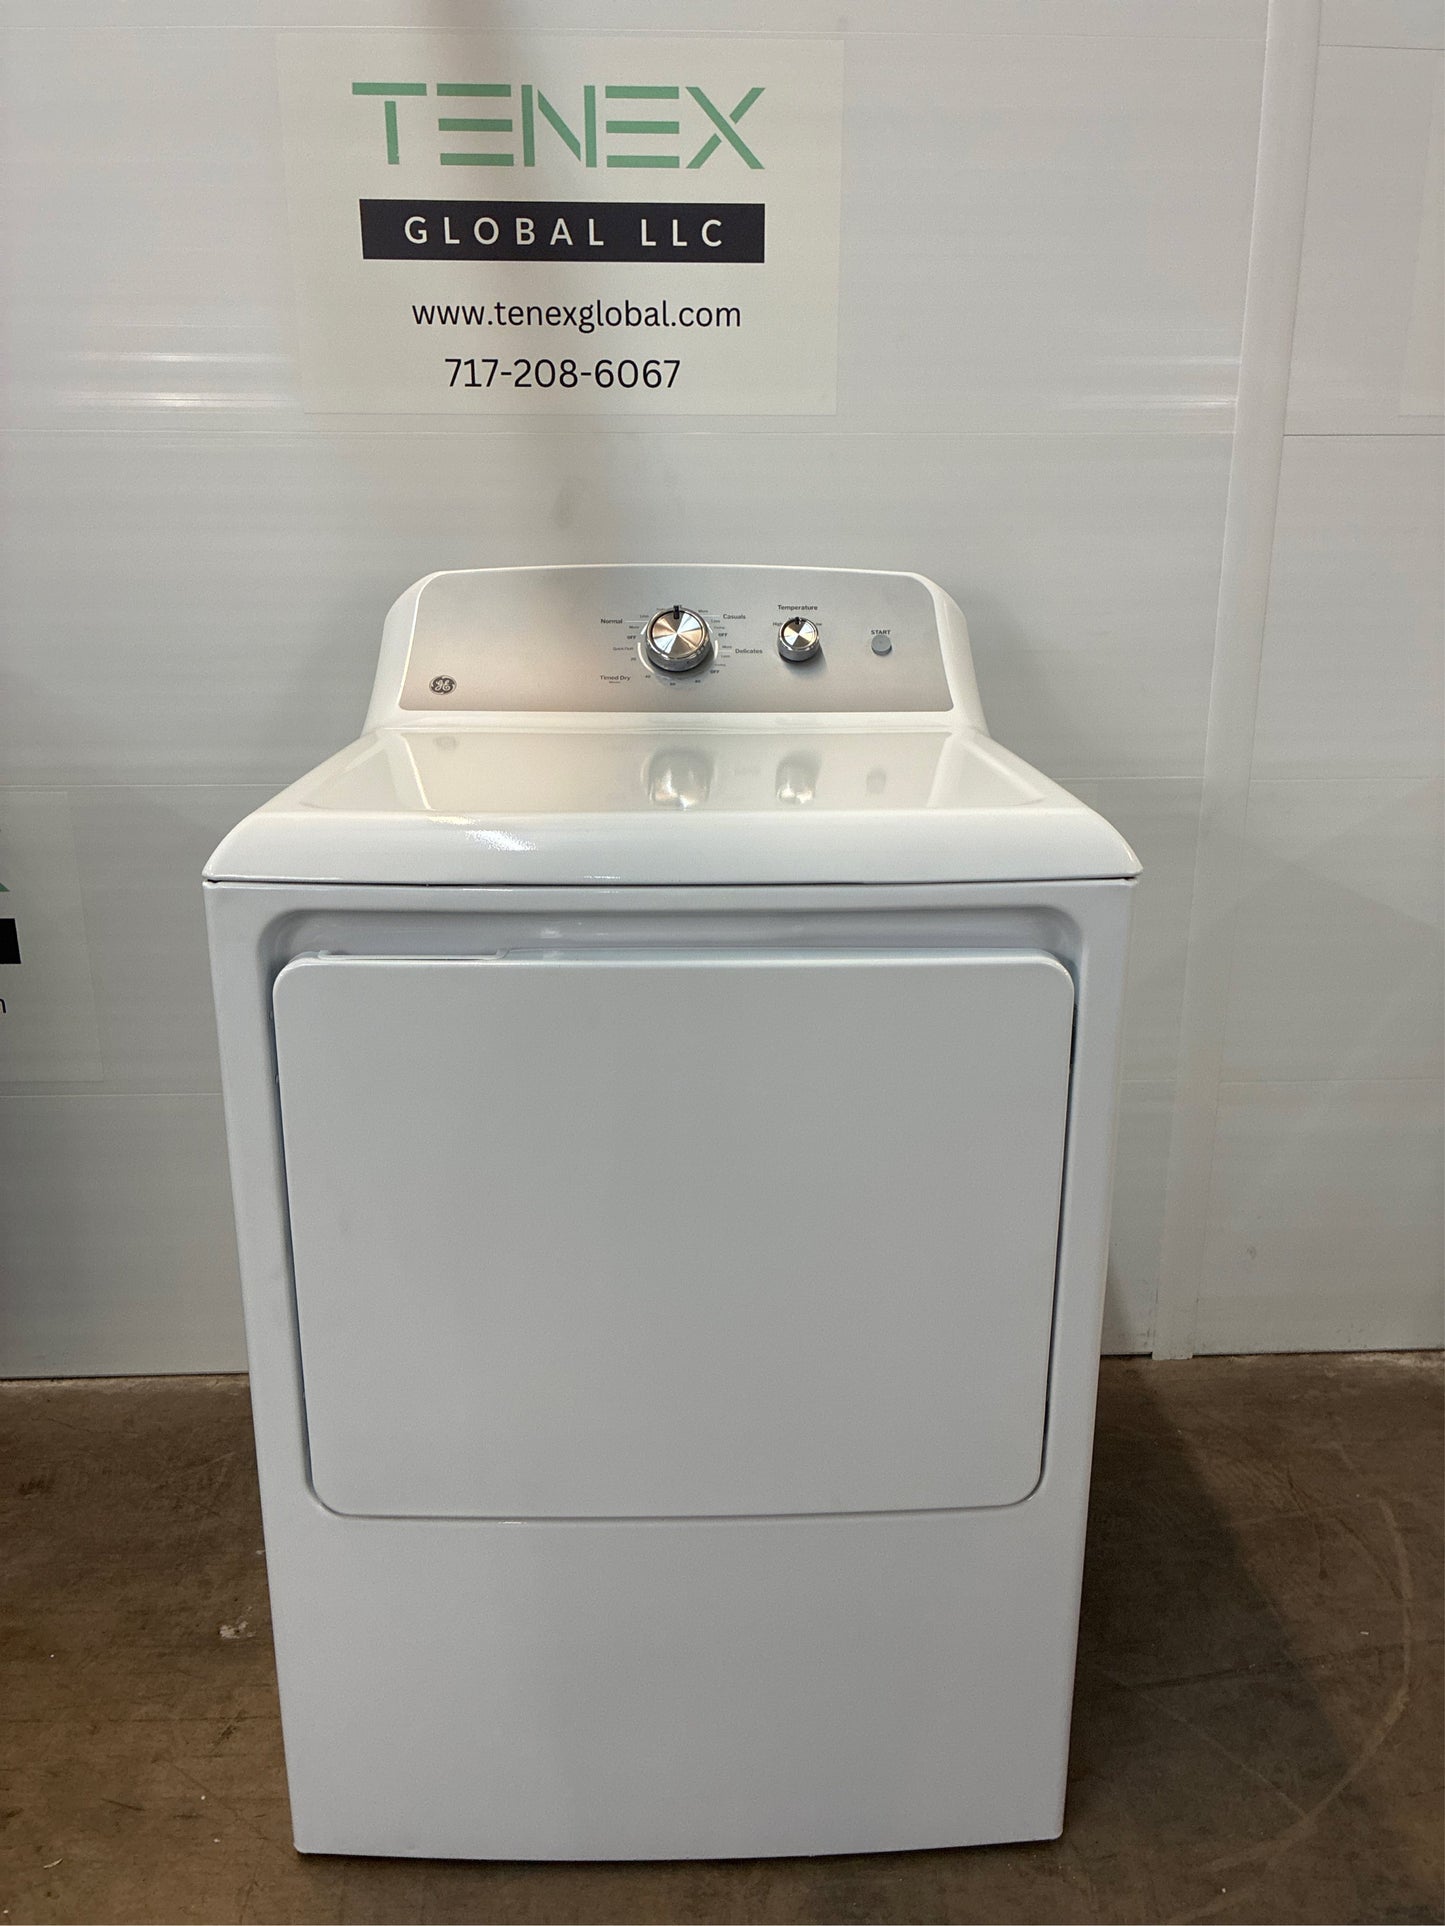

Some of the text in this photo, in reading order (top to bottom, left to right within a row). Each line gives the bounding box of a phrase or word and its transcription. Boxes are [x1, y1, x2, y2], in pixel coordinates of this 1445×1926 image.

[352, 82, 766, 170] TENEX
[404, 215, 724, 247] GLOBAL LLC
[412, 300, 742, 334] www.tenexglobal.com
[444, 357, 681, 389] 717-208-6067
